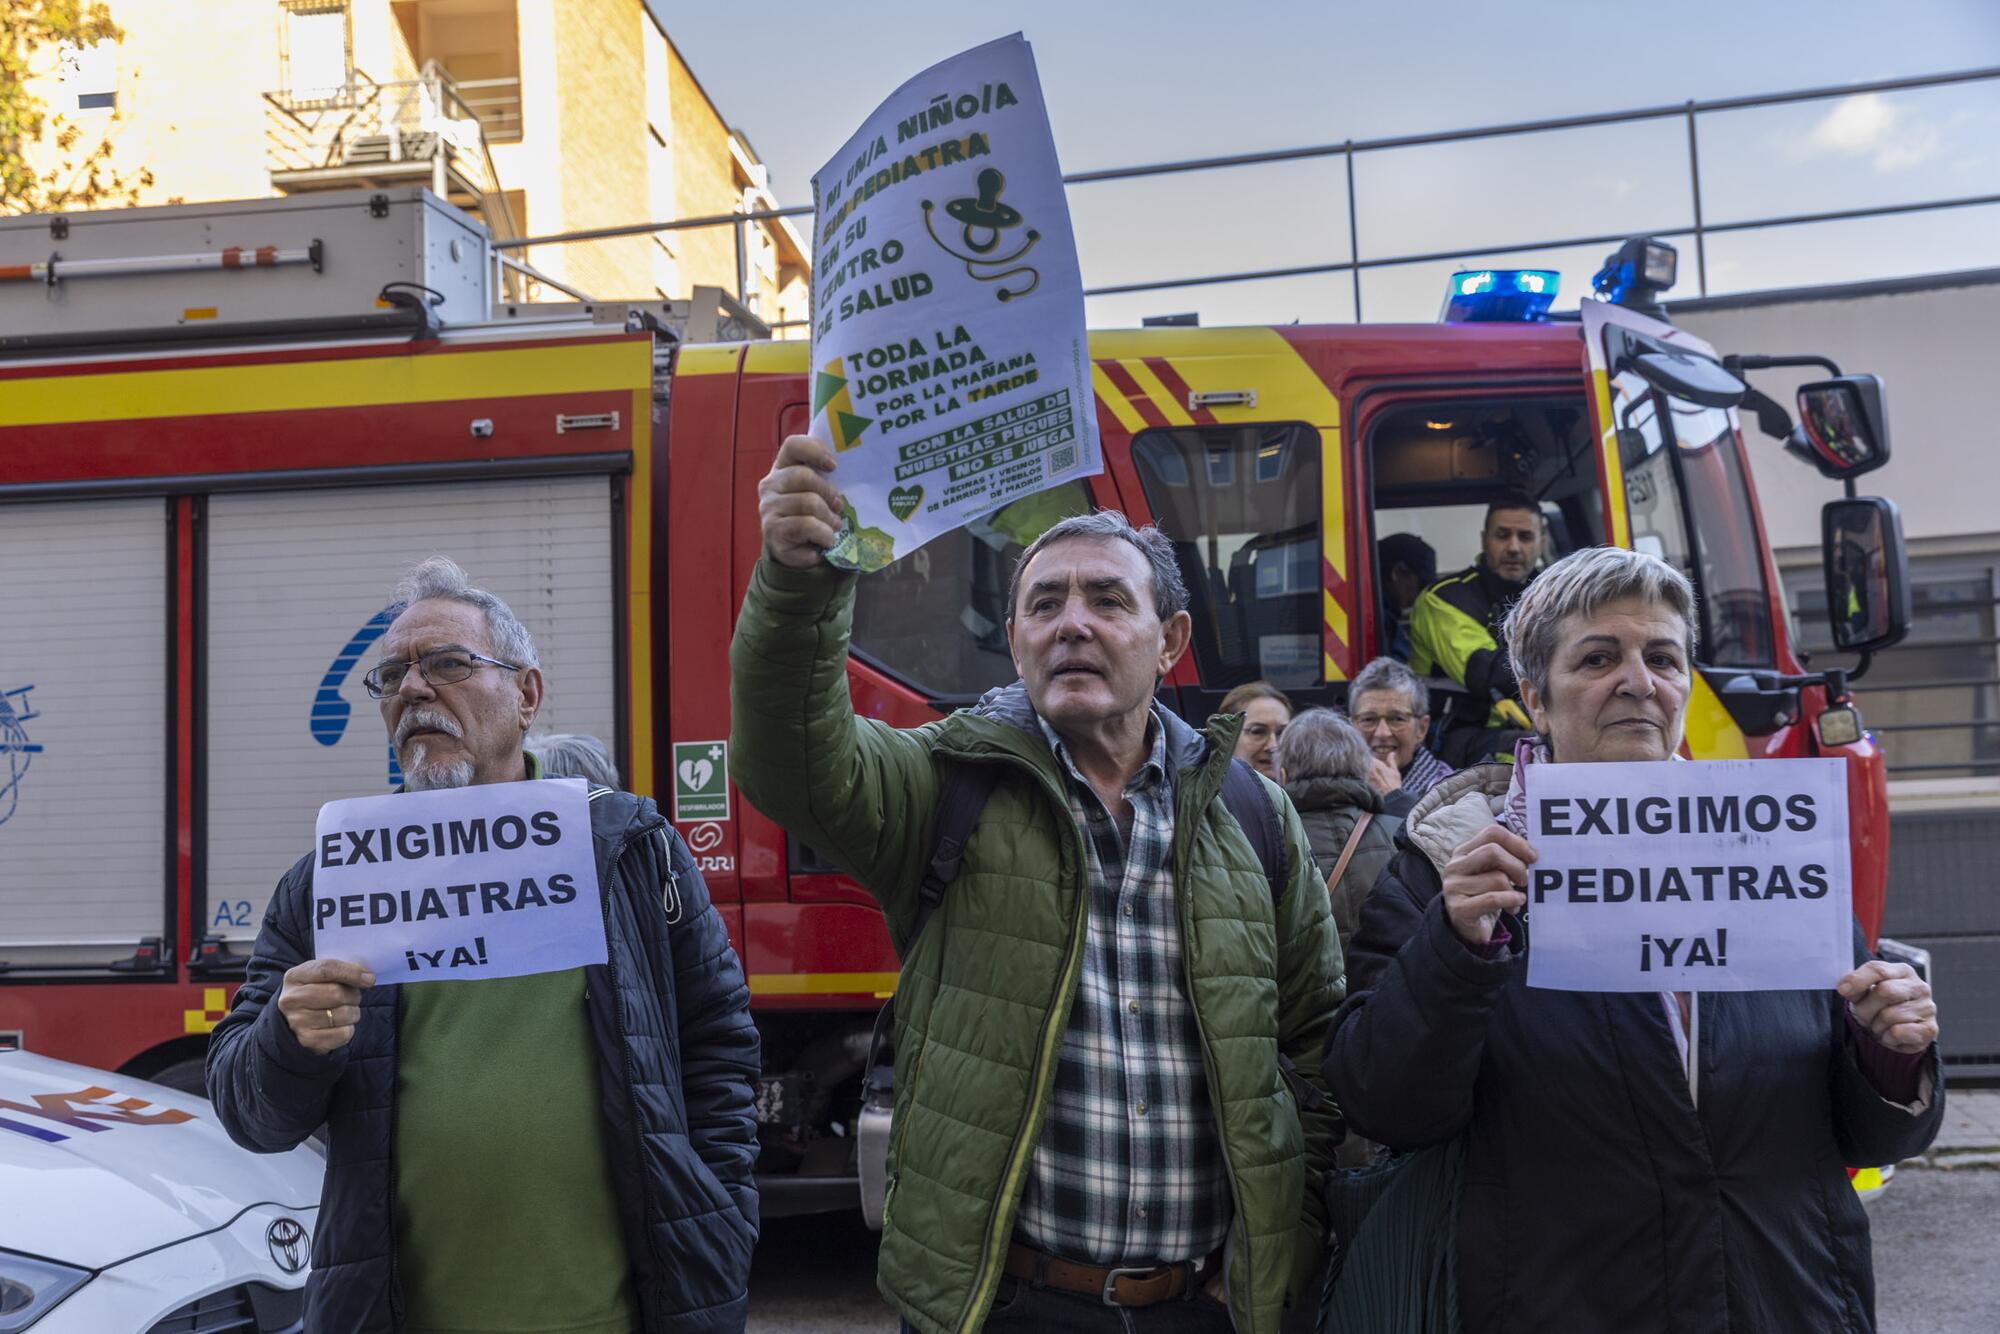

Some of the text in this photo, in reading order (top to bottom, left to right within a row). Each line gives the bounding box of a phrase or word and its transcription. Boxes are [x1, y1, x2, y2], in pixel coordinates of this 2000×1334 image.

[825, 82, 1018, 212] NI UN/A NIÑO/A
[823, 132, 991, 245] SIN PEDIATRA
[820, 239, 904, 310] CENTRO
[821, 216, 867, 279] EN SU
[817, 272, 933, 343] DE SALUD
[848, 325, 971, 373] TODA LA
[856, 345, 986, 399] JORNADA
[876, 352, 1036, 415] POR LA MAÑANA
[880, 369, 1039, 434] POR LA TARDE
[899, 411, 1070, 479] NUESTRAS PEQUES
[905, 391, 1069, 458] CON LA SALUD DE
[943, 456, 1042, 496] VECINAS Y VECINOS
[954, 429, 1072, 478] NO SE JUEGA
[927, 503, 939, 513] DE
[942, 486, 987, 507] BARRIOS
[990, 482, 997, 490] Y
[1000, 466, 1043, 485] PUEBLOS
[990, 475, 1043, 499] DE MADRID
[321, 811, 561, 868] EXIGIMOS
[1539, 794, 1817, 836] EXIGIMOS
[693, 856, 734, 871] URRI
[1534, 864, 1828, 904] PEDIATRAS
[214, 900, 252, 926] A2
[317, 873, 577, 930] PEDIATRAS
[405, 936, 488, 971] ¡YA!
[1640, 928, 1727, 972] ¡YA!
